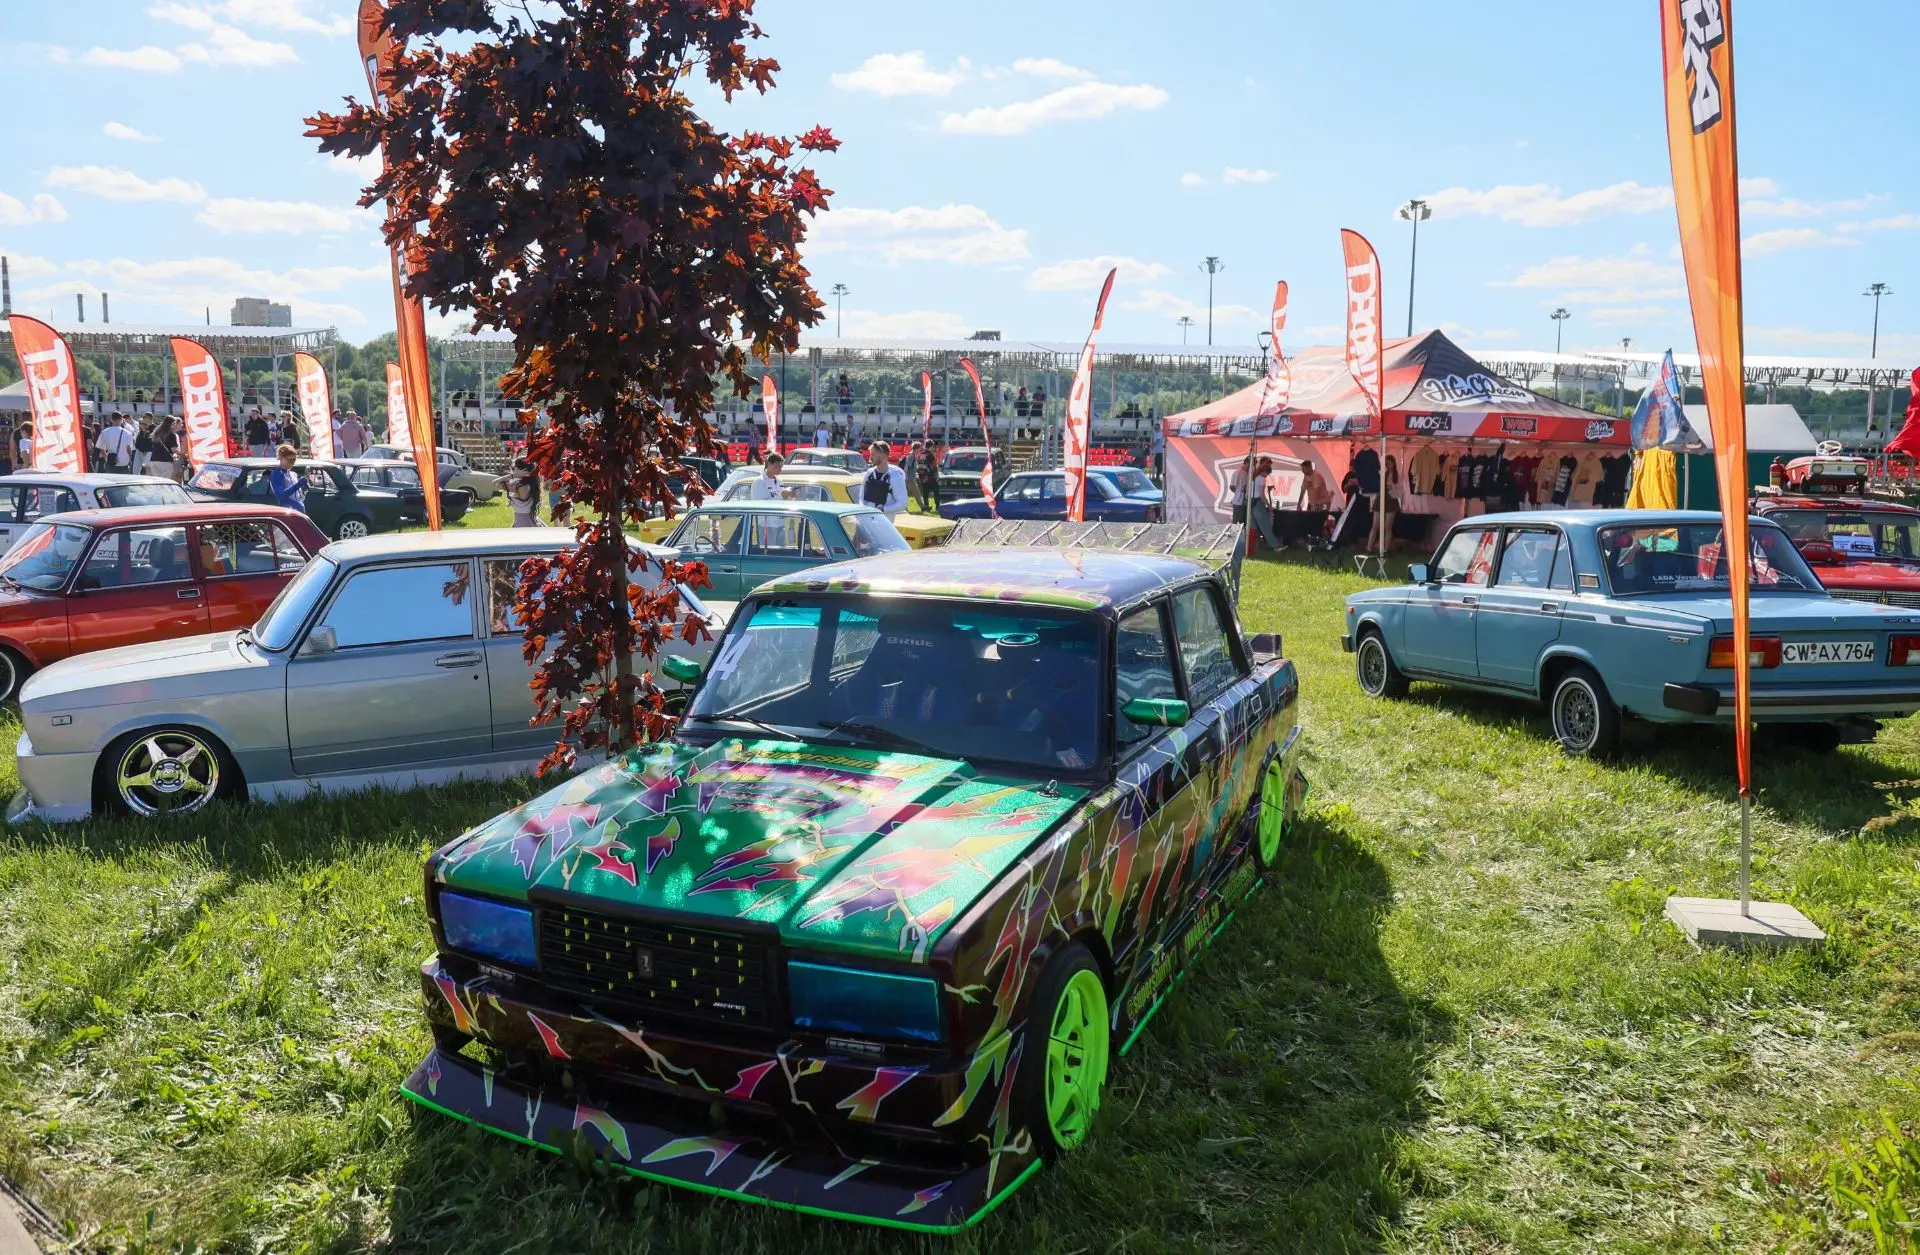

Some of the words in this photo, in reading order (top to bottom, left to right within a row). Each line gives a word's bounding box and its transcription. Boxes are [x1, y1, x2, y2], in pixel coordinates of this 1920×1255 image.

[706, 633, 753, 681] 14
[1784, 645, 1810, 661] CW
[1819, 643, 1841, 661] AX
[1845, 643, 1873, 660] 764
